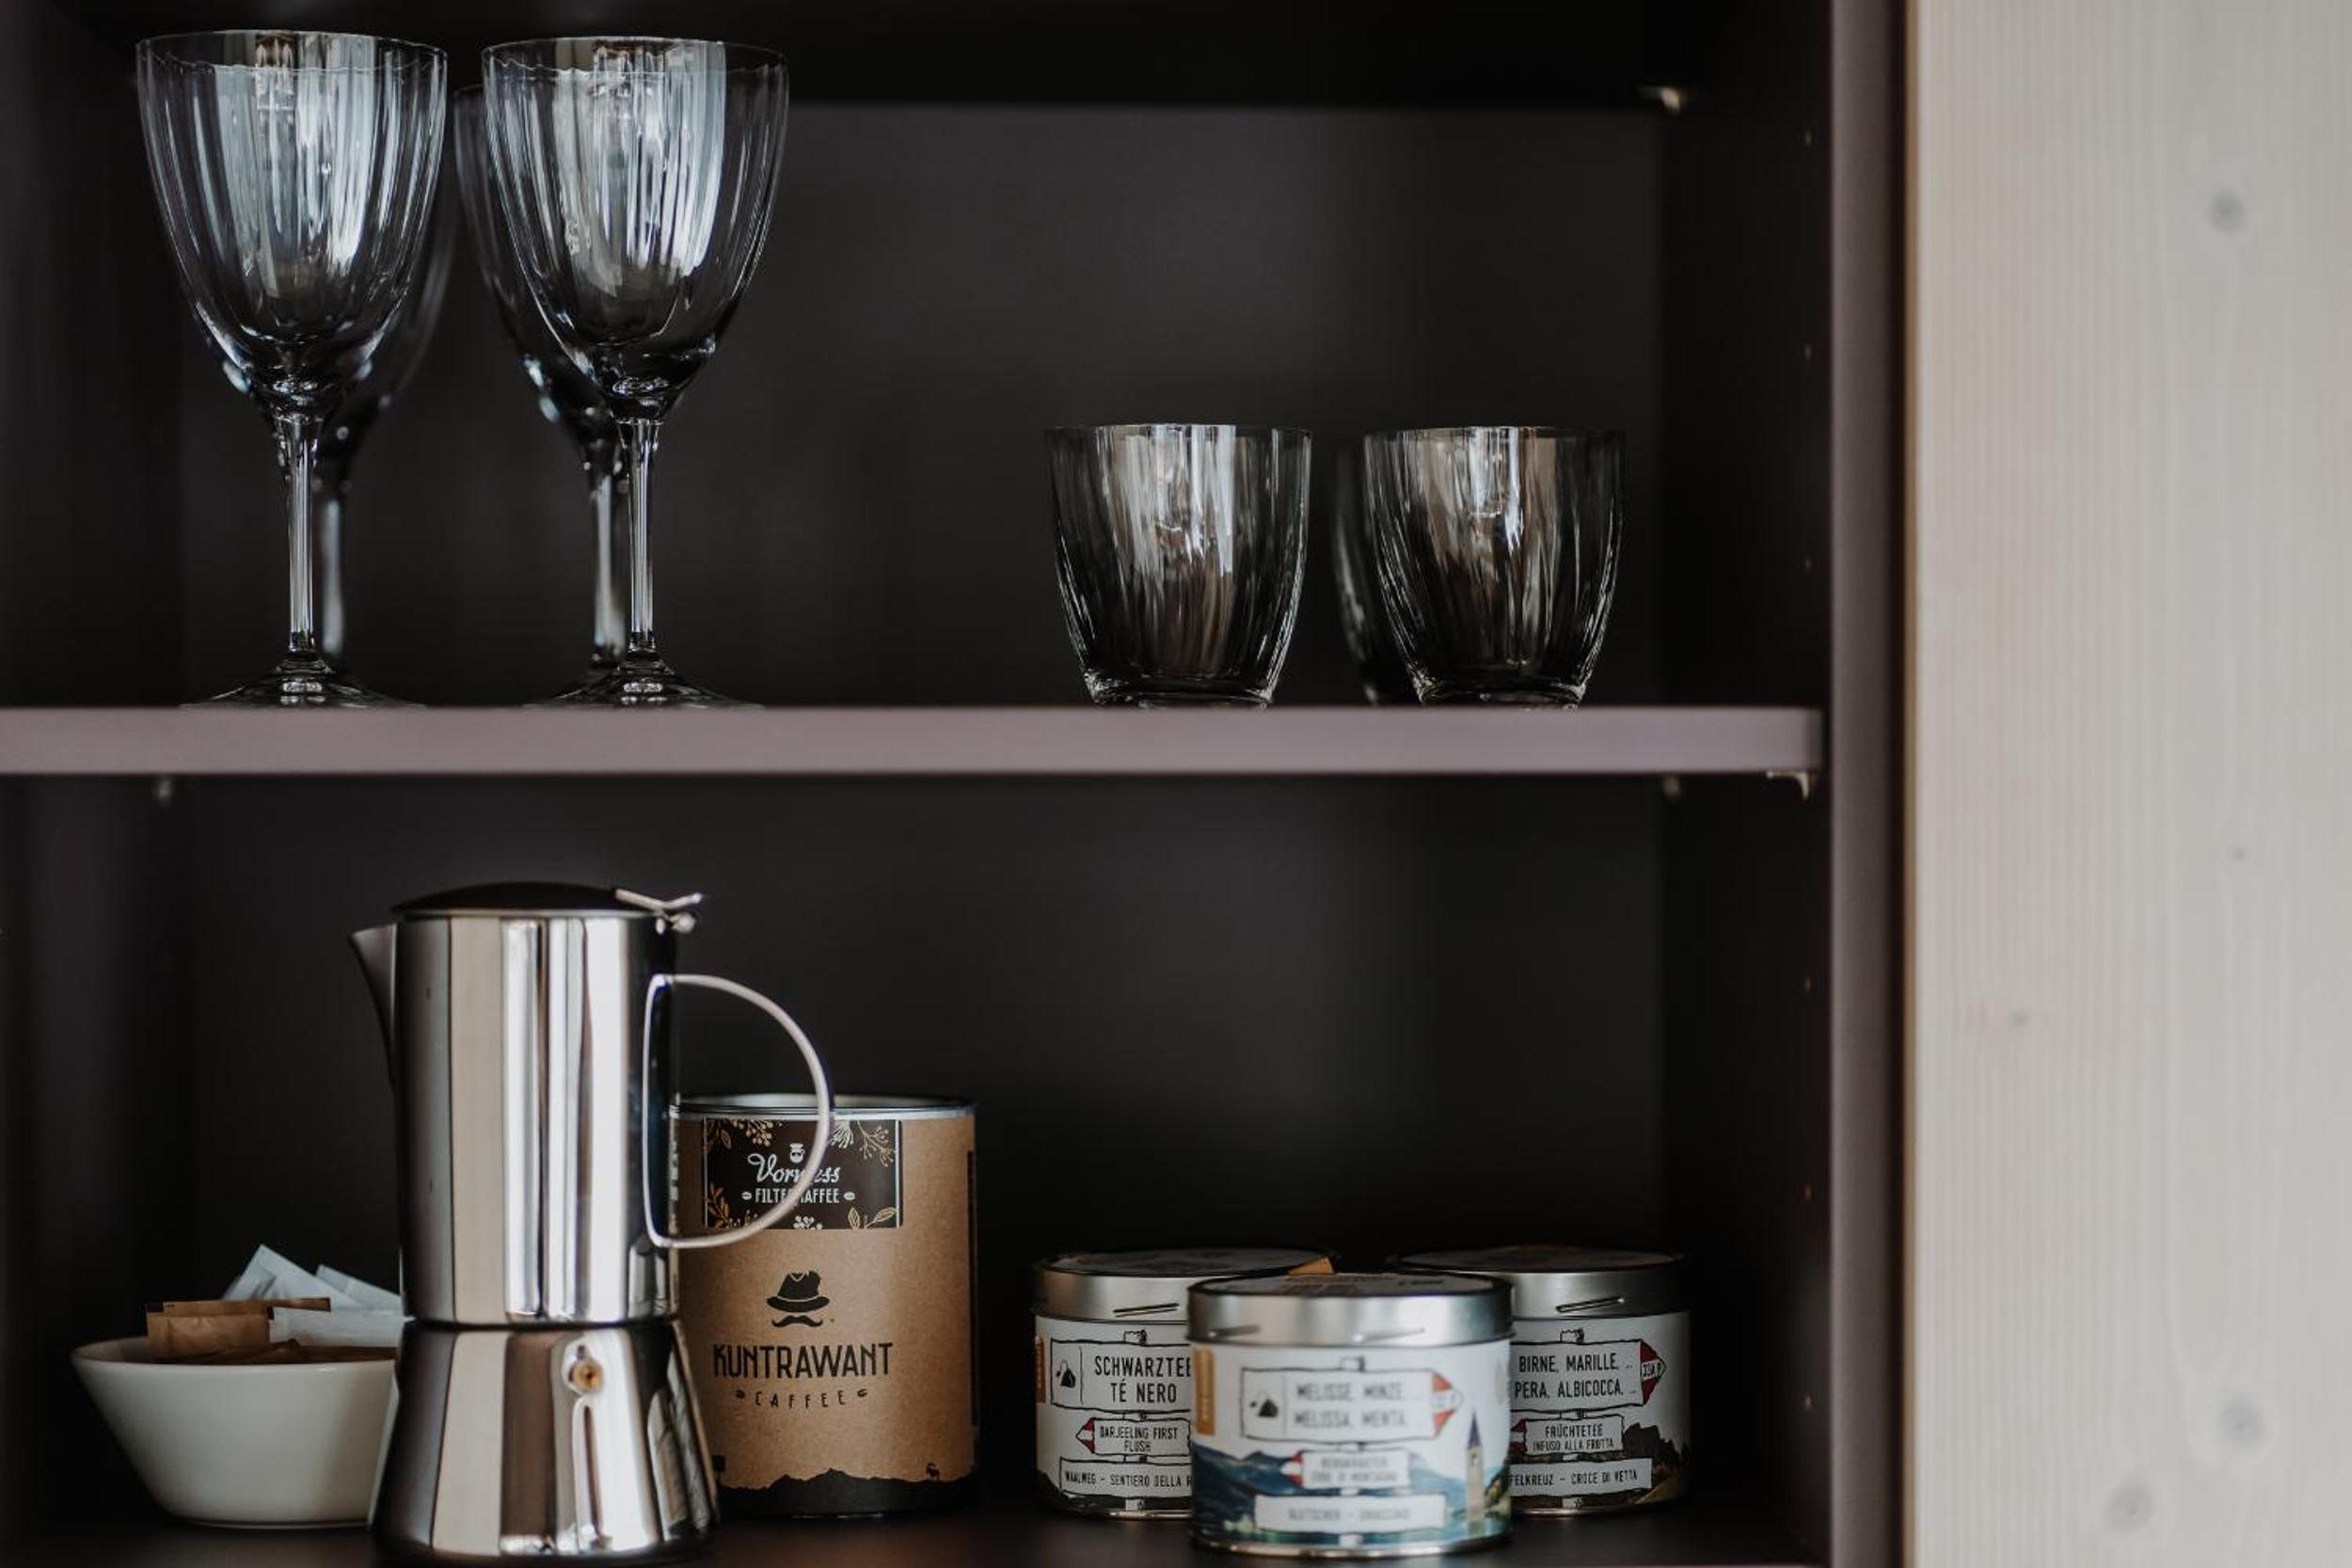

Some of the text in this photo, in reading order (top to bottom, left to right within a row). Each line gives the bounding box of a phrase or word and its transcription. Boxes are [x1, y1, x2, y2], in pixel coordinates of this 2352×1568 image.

[713, 1342, 893, 1378] KUNTRAWANT
[755, 1389, 846, 1409] CAFFEE
[1136, 1382, 1177, 1403] NERO
[1100, 1426, 1178, 1440] DARJEELING FIRST
[1545, 1422, 1603, 1438] FRÜCHTETEE
[1124, 1440, 1152, 1452] FLUSH
[1533, 1438, 1614, 1451] INFUSO ALLA FRUTTA
[1110, 1475, 1149, 1487] SENTIERO
[1154, 1475, 1182, 1487] DELLA
[1571, 1472, 1597, 1485] CROCE
[1602, 1471, 1611, 1483] DI
[1614, 1469, 1638, 1482] VETTA
